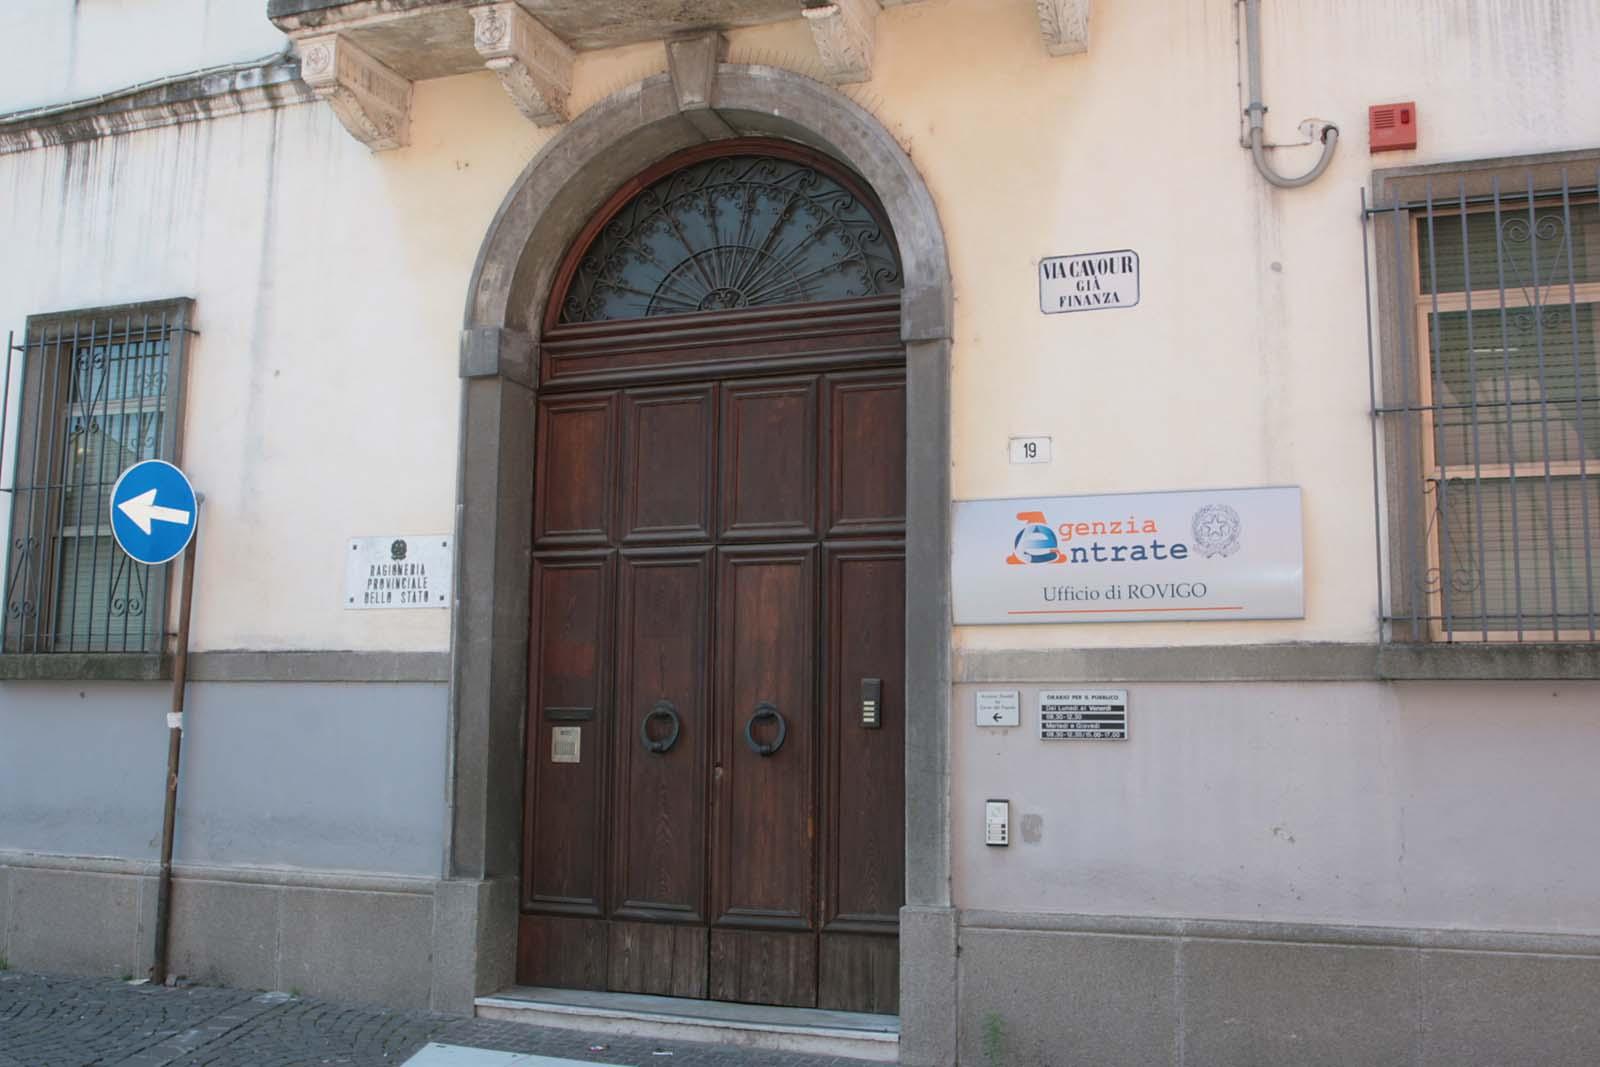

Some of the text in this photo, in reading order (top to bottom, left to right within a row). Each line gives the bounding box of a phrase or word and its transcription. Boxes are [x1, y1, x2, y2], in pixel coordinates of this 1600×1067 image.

[1043, 256, 1133, 280] VIA CAVOUR
[1059, 291, 1120, 308] FINANZA
[1023, 442, 1037, 459] 19
[370, 562, 425, 577] RAGIONERIA
[367, 576, 429, 590] PROVINCIALE
[363, 590, 429, 604] DELLO STATO
[1042, 582, 1208, 602] Ufficio di ROVIGO
